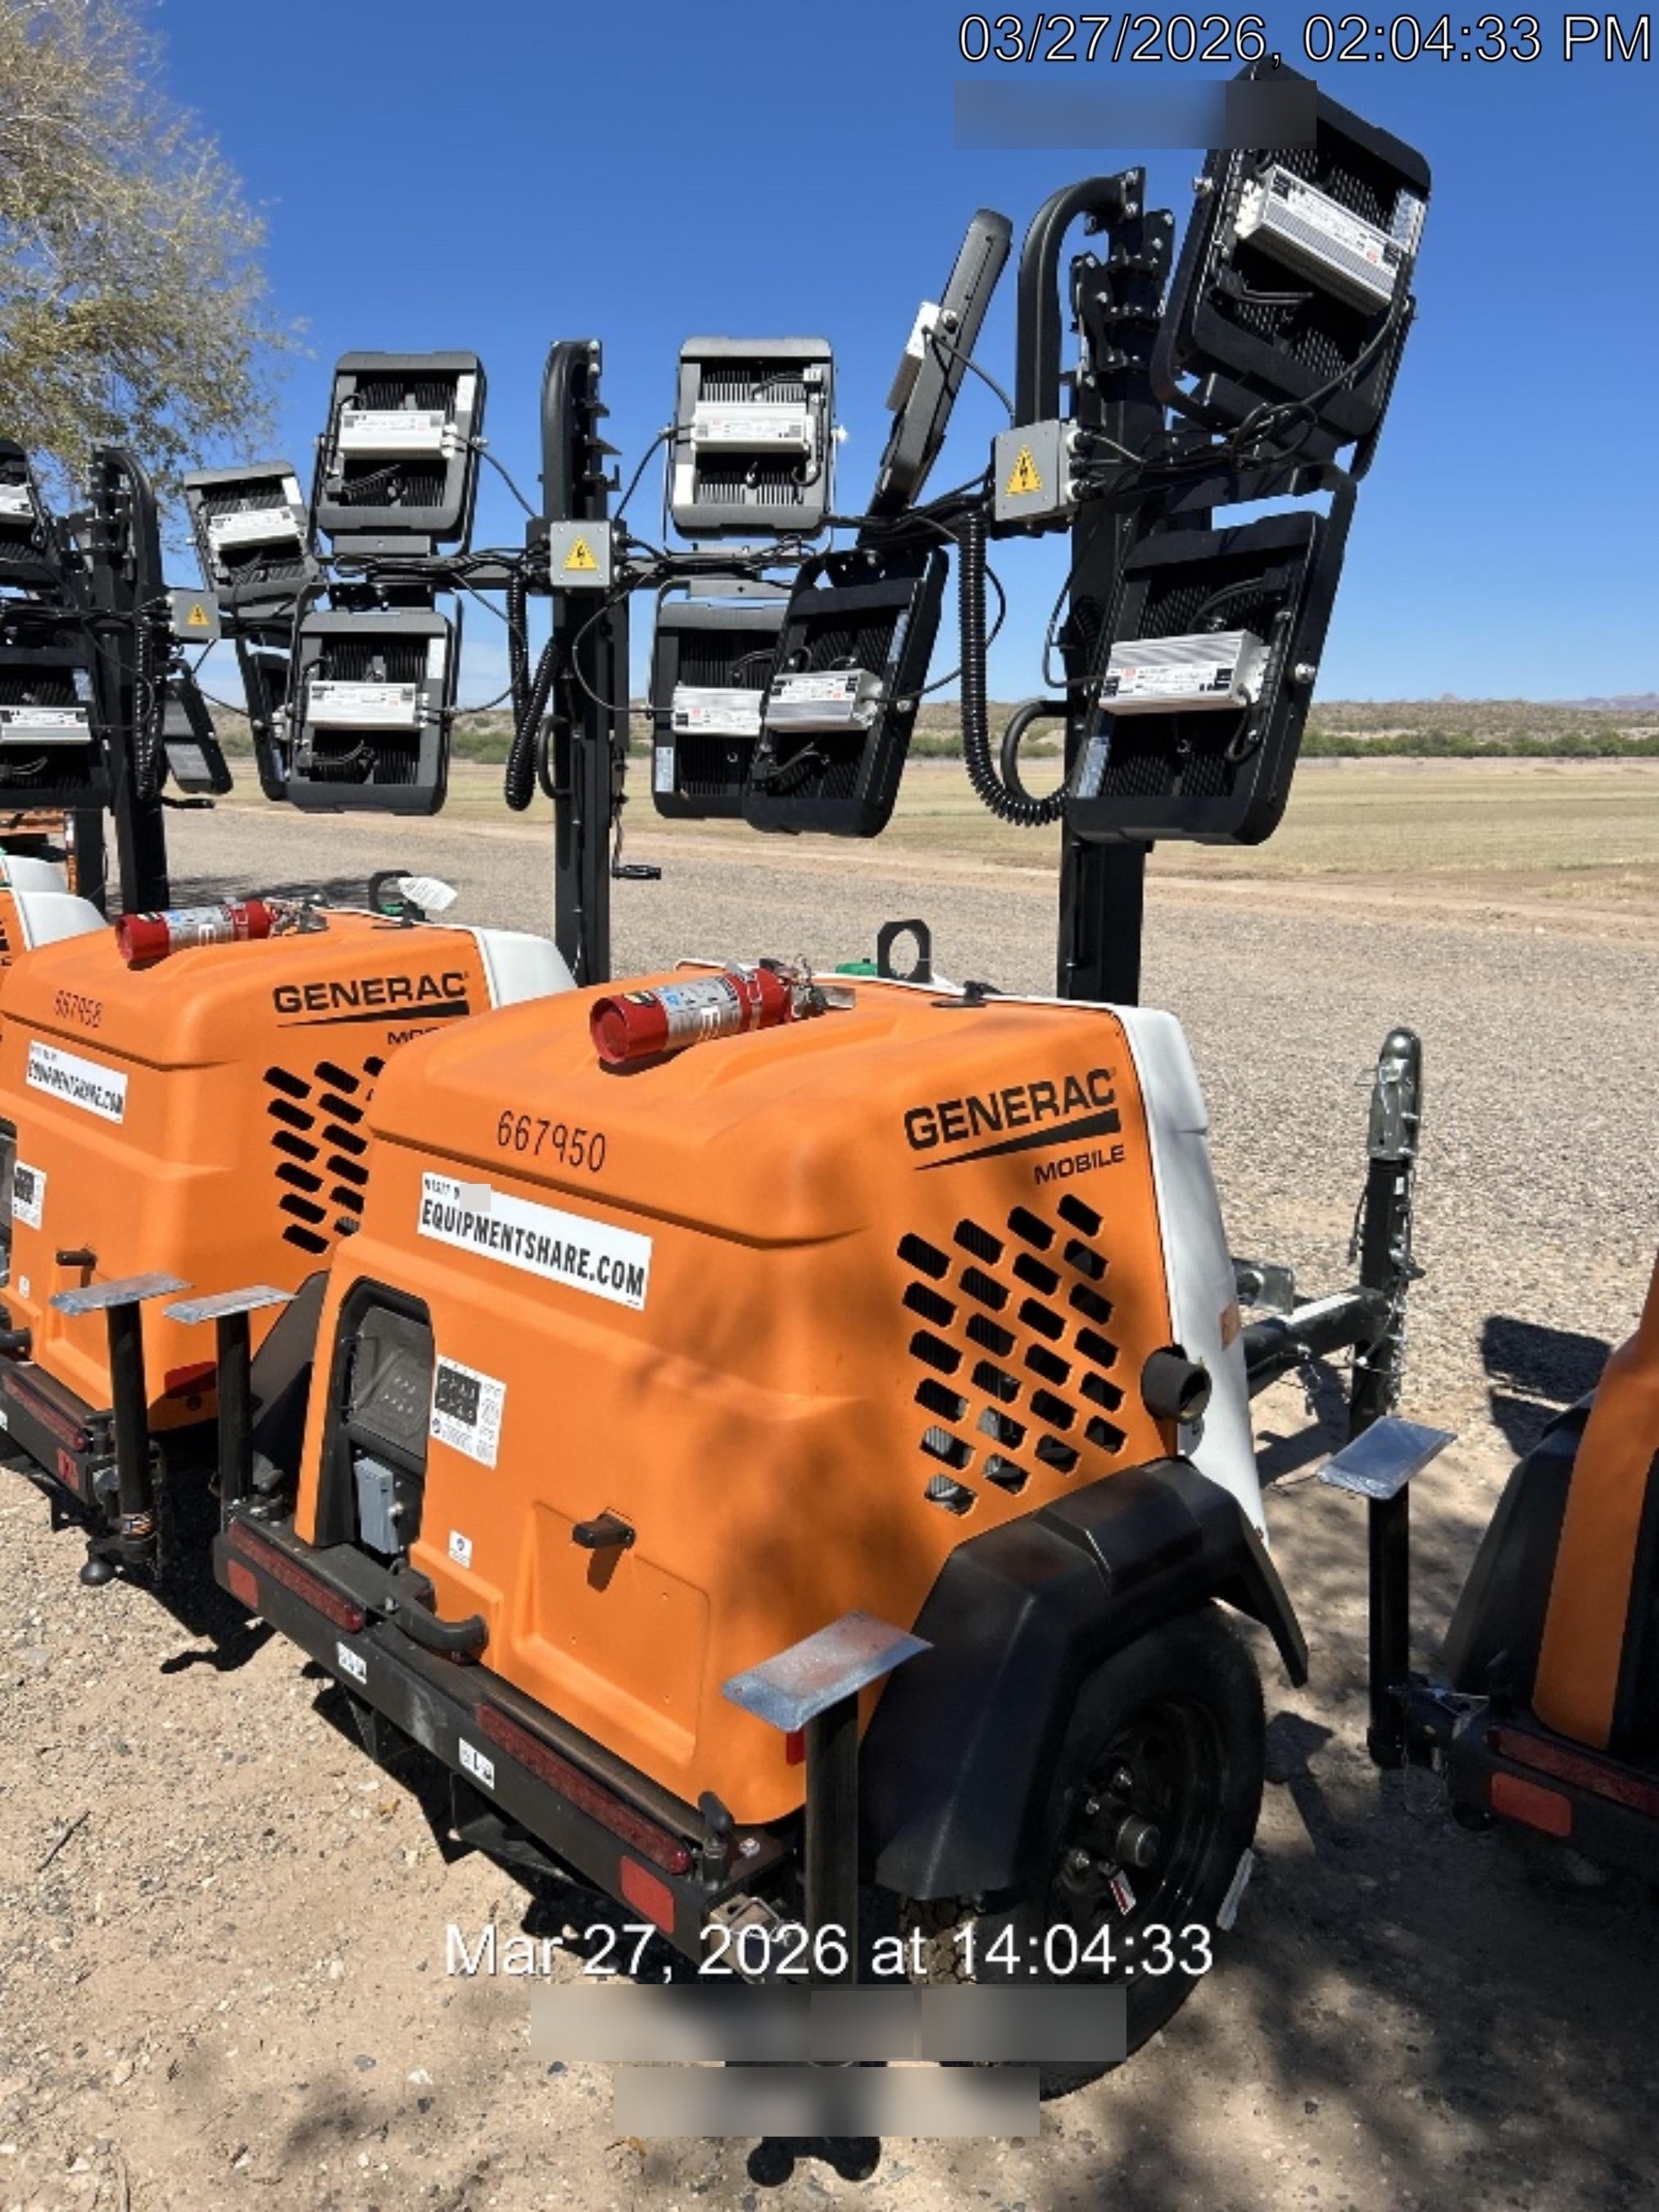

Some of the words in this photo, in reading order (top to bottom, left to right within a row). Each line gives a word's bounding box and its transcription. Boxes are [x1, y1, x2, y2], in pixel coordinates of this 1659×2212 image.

[273, 971, 467, 1013] GENERAC
[904, 1068, 1115, 1150] GENERAC
[498, 1110, 605, 1172] 667950
[1034, 1145, 1125, 1185] MOBILE
[422, 1199, 644, 1296] EQUIPMENTSHARE.COM
